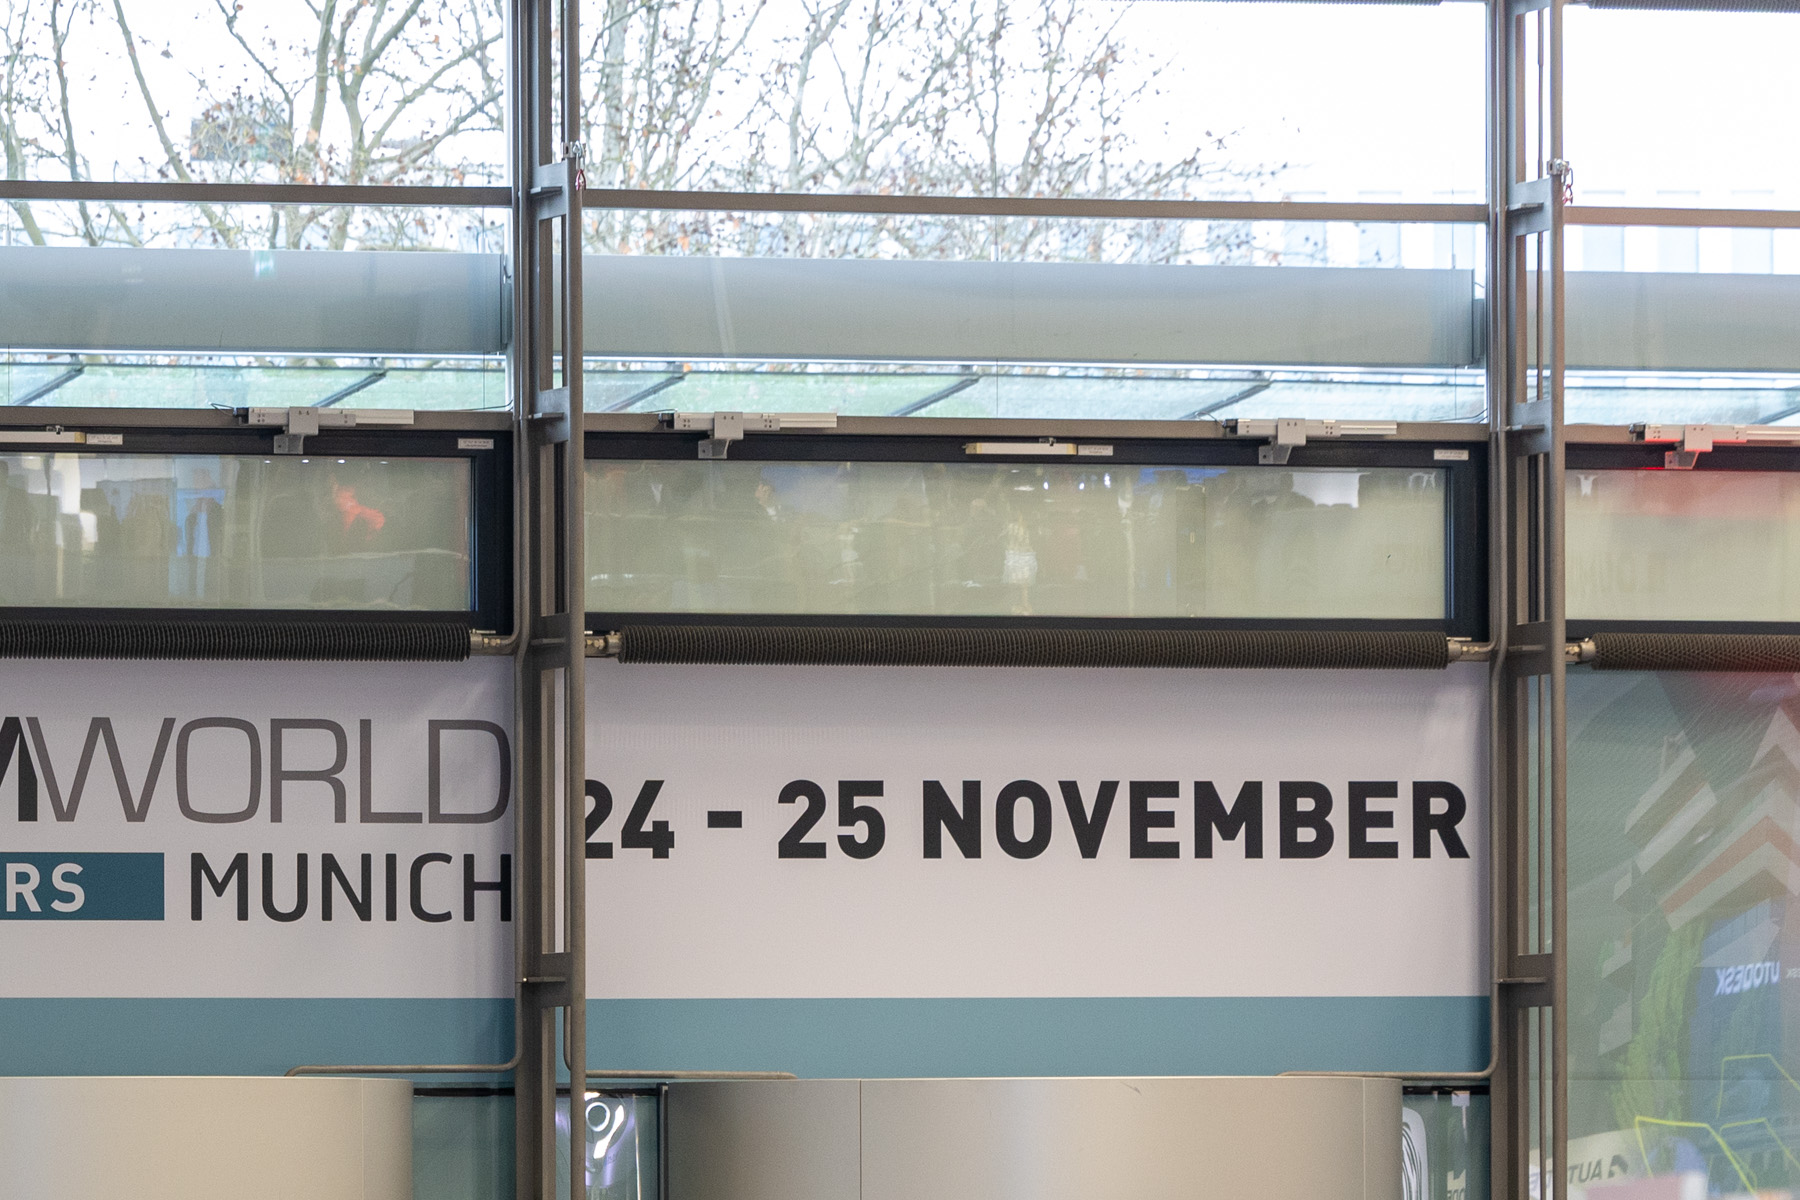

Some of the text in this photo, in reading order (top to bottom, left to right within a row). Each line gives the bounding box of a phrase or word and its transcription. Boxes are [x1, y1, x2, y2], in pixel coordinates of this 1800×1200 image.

[584, 779, 1471, 860] 24 - 25 NOVEMBER
[190, 852, 512, 923] MUNICH
